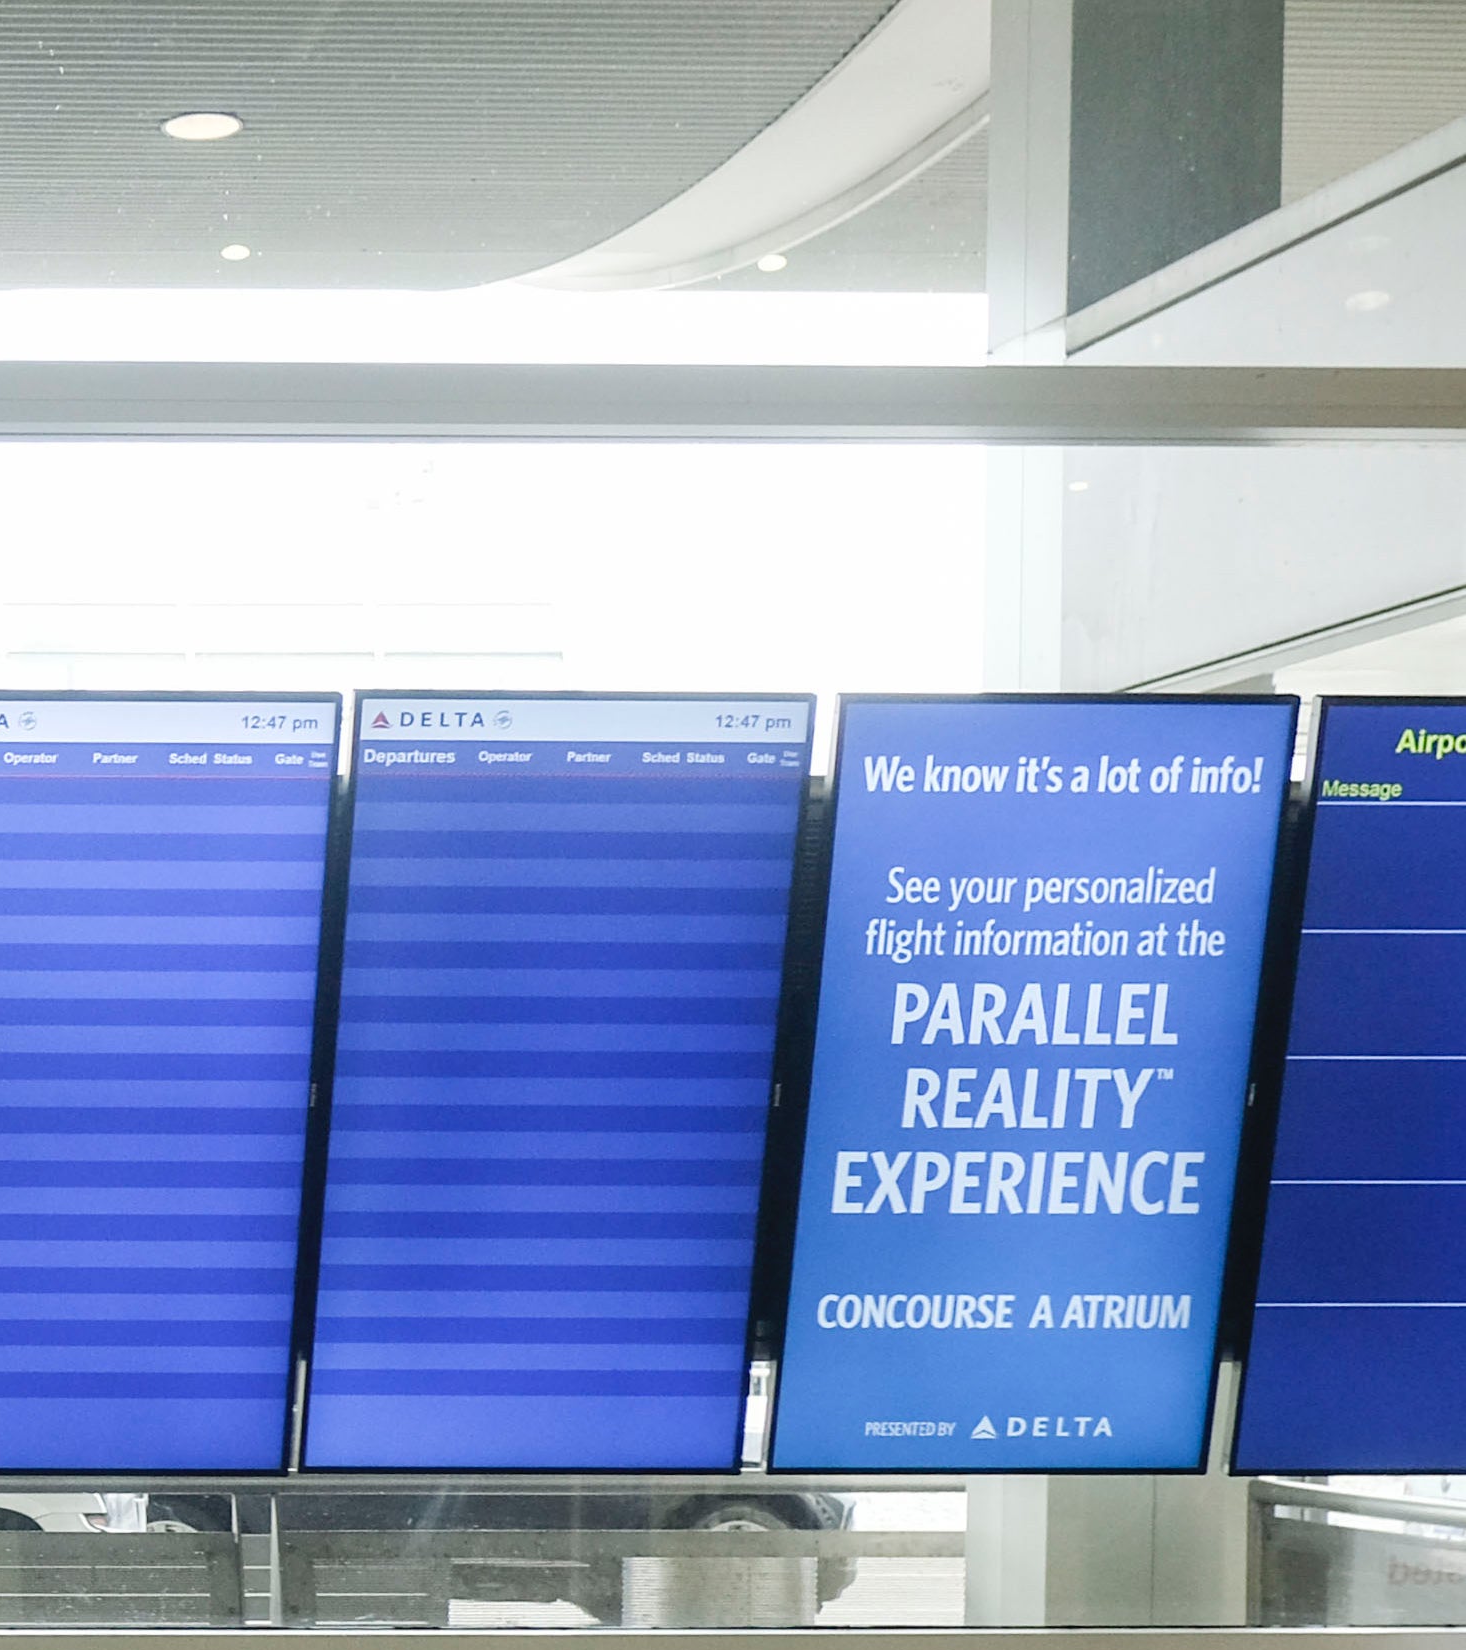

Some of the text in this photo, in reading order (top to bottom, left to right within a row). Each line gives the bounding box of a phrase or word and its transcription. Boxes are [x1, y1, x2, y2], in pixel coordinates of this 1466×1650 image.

[242, 716, 318, 732] 12:47 pm
[400, 712, 484, 727] DELTA
[716, 715, 791, 731] 12:47 pm
[4, 752, 58, 765] Operator
[93, 753, 138, 763] Partner
[169, 753, 207, 764] Sched
[214, 753, 252, 764] Status
[275, 754, 304, 764] Gate
[364, 749, 455, 766] Departures
[479, 751, 532, 764] Operator
[567, 751, 611, 762] Partner
[642, 752, 680, 763] Sched
[687, 752, 725, 763] Status
[747, 752, 775, 763] Gate
[865, 755, 1263, 793] We know it's a lot of info!
[1322, 780, 1402, 801] Message
[886, 866, 1215, 912] See your personalized
[866, 919, 1225, 963] flight information at the
[891, 983, 1177, 1045] PARALLEL
[832, 1151, 1204, 1215] EXPERIENCE
[818, 1295, 1190, 1329] CONCOURSE A ATRIUM
[865, 1422, 956, 1436] PRESENTED BY
[1007, 1417, 1112, 1436] DELTA
